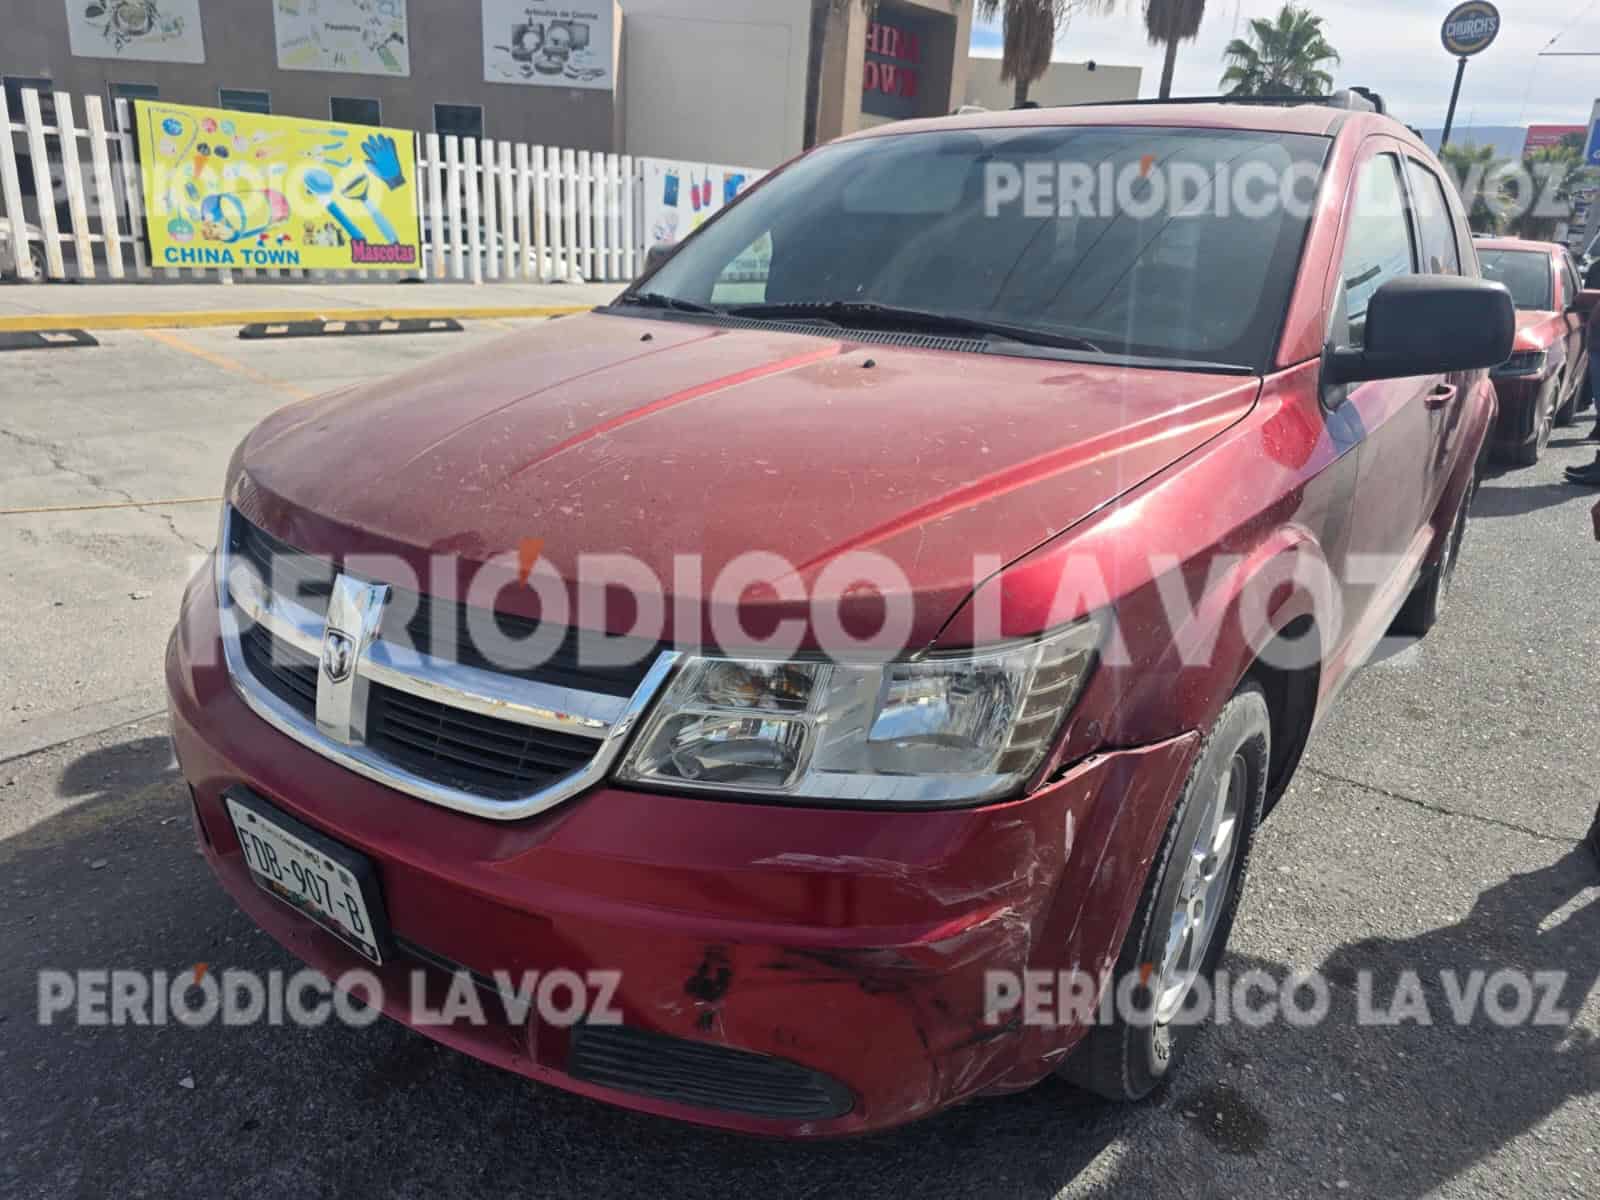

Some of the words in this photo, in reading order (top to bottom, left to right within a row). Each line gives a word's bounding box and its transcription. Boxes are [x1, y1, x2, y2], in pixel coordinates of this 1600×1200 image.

[164, 246, 235, 264] CHINA
[240, 249, 300, 265] TOWN
[351, 239, 416, 264] Mascotas
[238, 826, 366, 936] FDB-907-B
